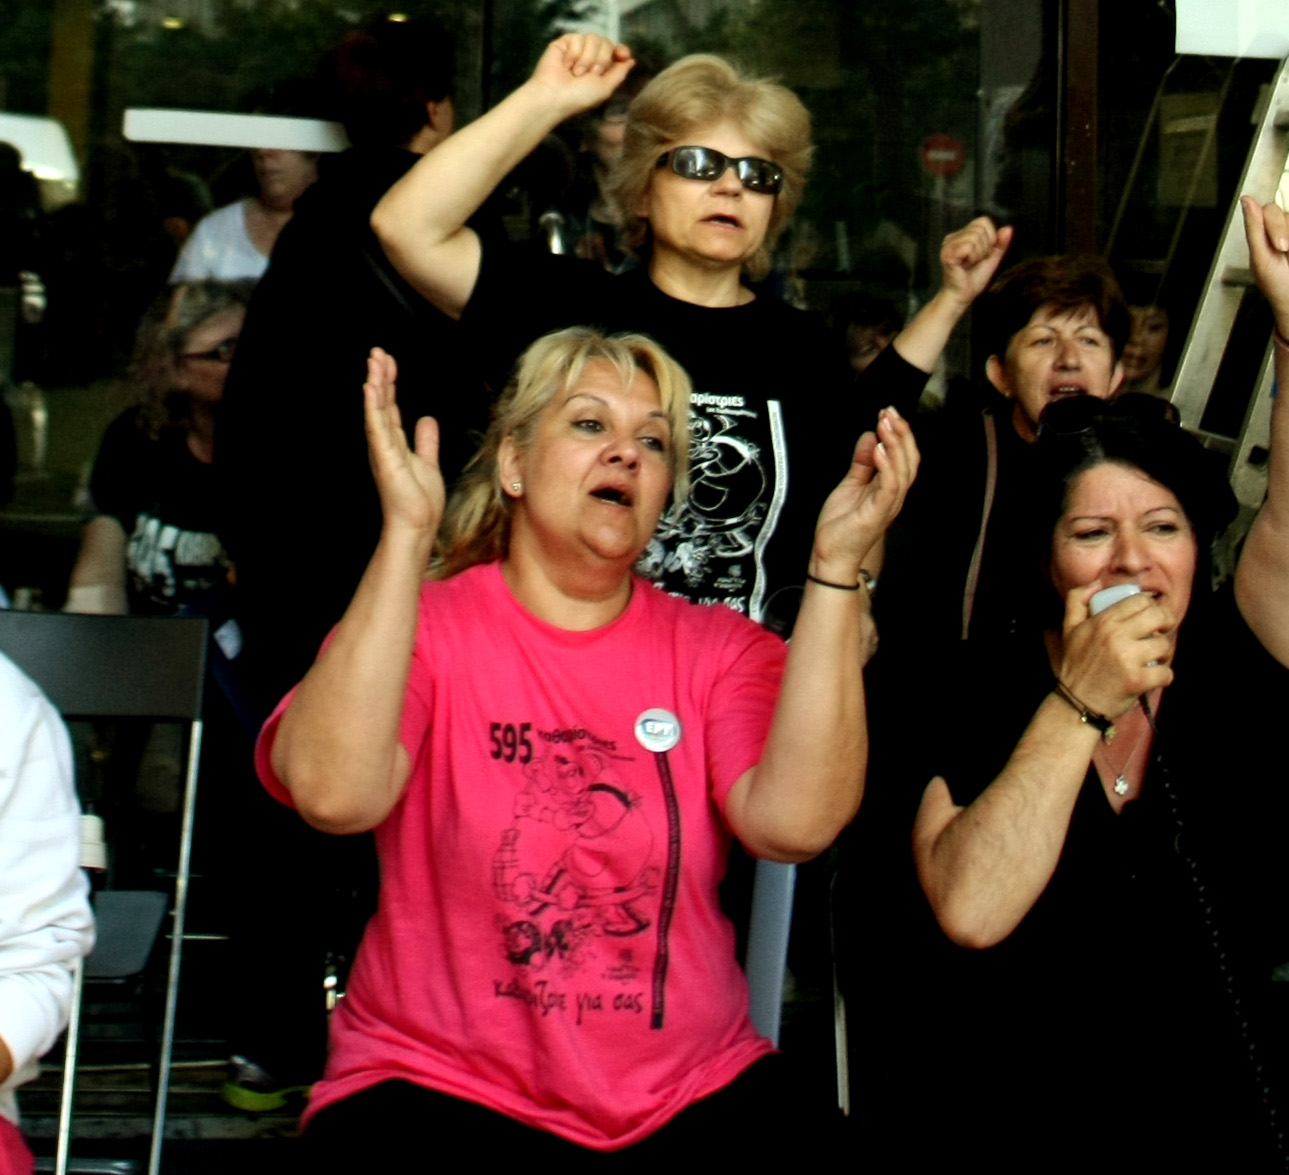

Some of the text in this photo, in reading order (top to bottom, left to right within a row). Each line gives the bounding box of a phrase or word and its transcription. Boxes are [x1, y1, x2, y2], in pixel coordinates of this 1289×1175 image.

[490, 722, 533, 764] 595
[576, 991, 604, 1026] για
[613, 992, 644, 1014] σας
